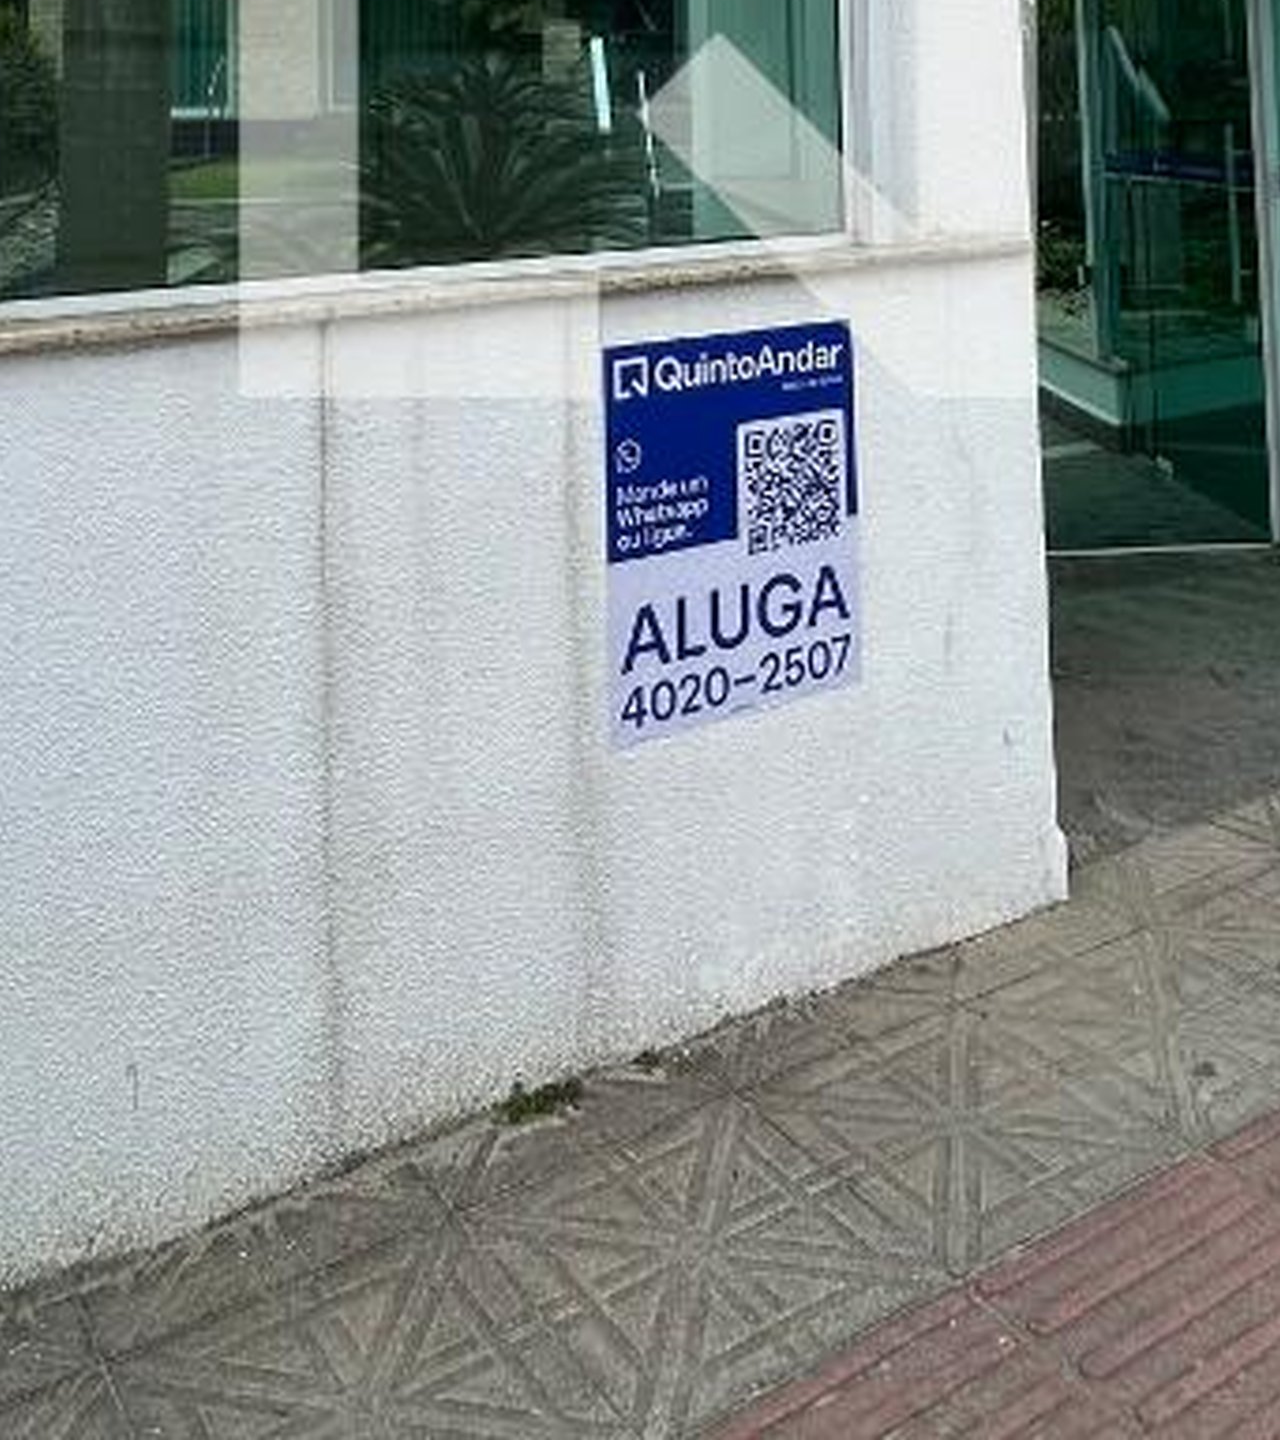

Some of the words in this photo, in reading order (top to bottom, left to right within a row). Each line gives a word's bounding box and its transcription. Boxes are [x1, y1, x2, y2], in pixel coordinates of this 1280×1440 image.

[653, 341, 844, 393] QuintoAndar
[621, 564, 851, 676] ALUGA
[621, 633, 852, 729] 4020-2507
